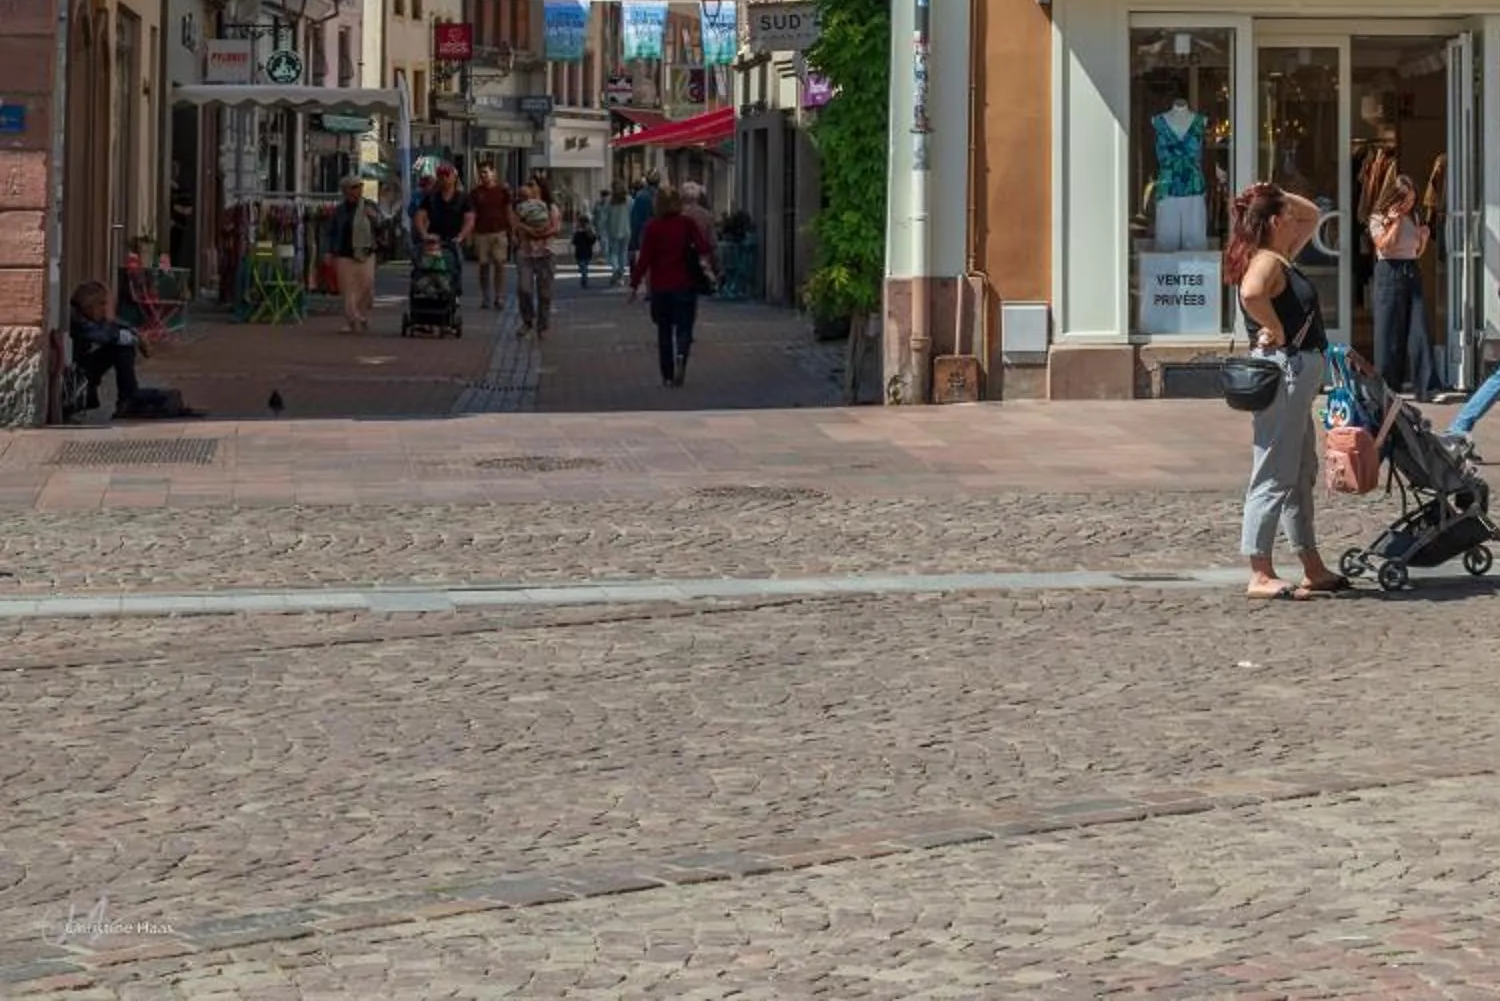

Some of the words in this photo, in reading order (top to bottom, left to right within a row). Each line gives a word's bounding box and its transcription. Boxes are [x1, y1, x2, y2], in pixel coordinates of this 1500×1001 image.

[760, 14, 801, 31] SUD
[1156, 274, 1204, 287] VENTES
[1152, 290, 1206, 306] PRIVÉES
